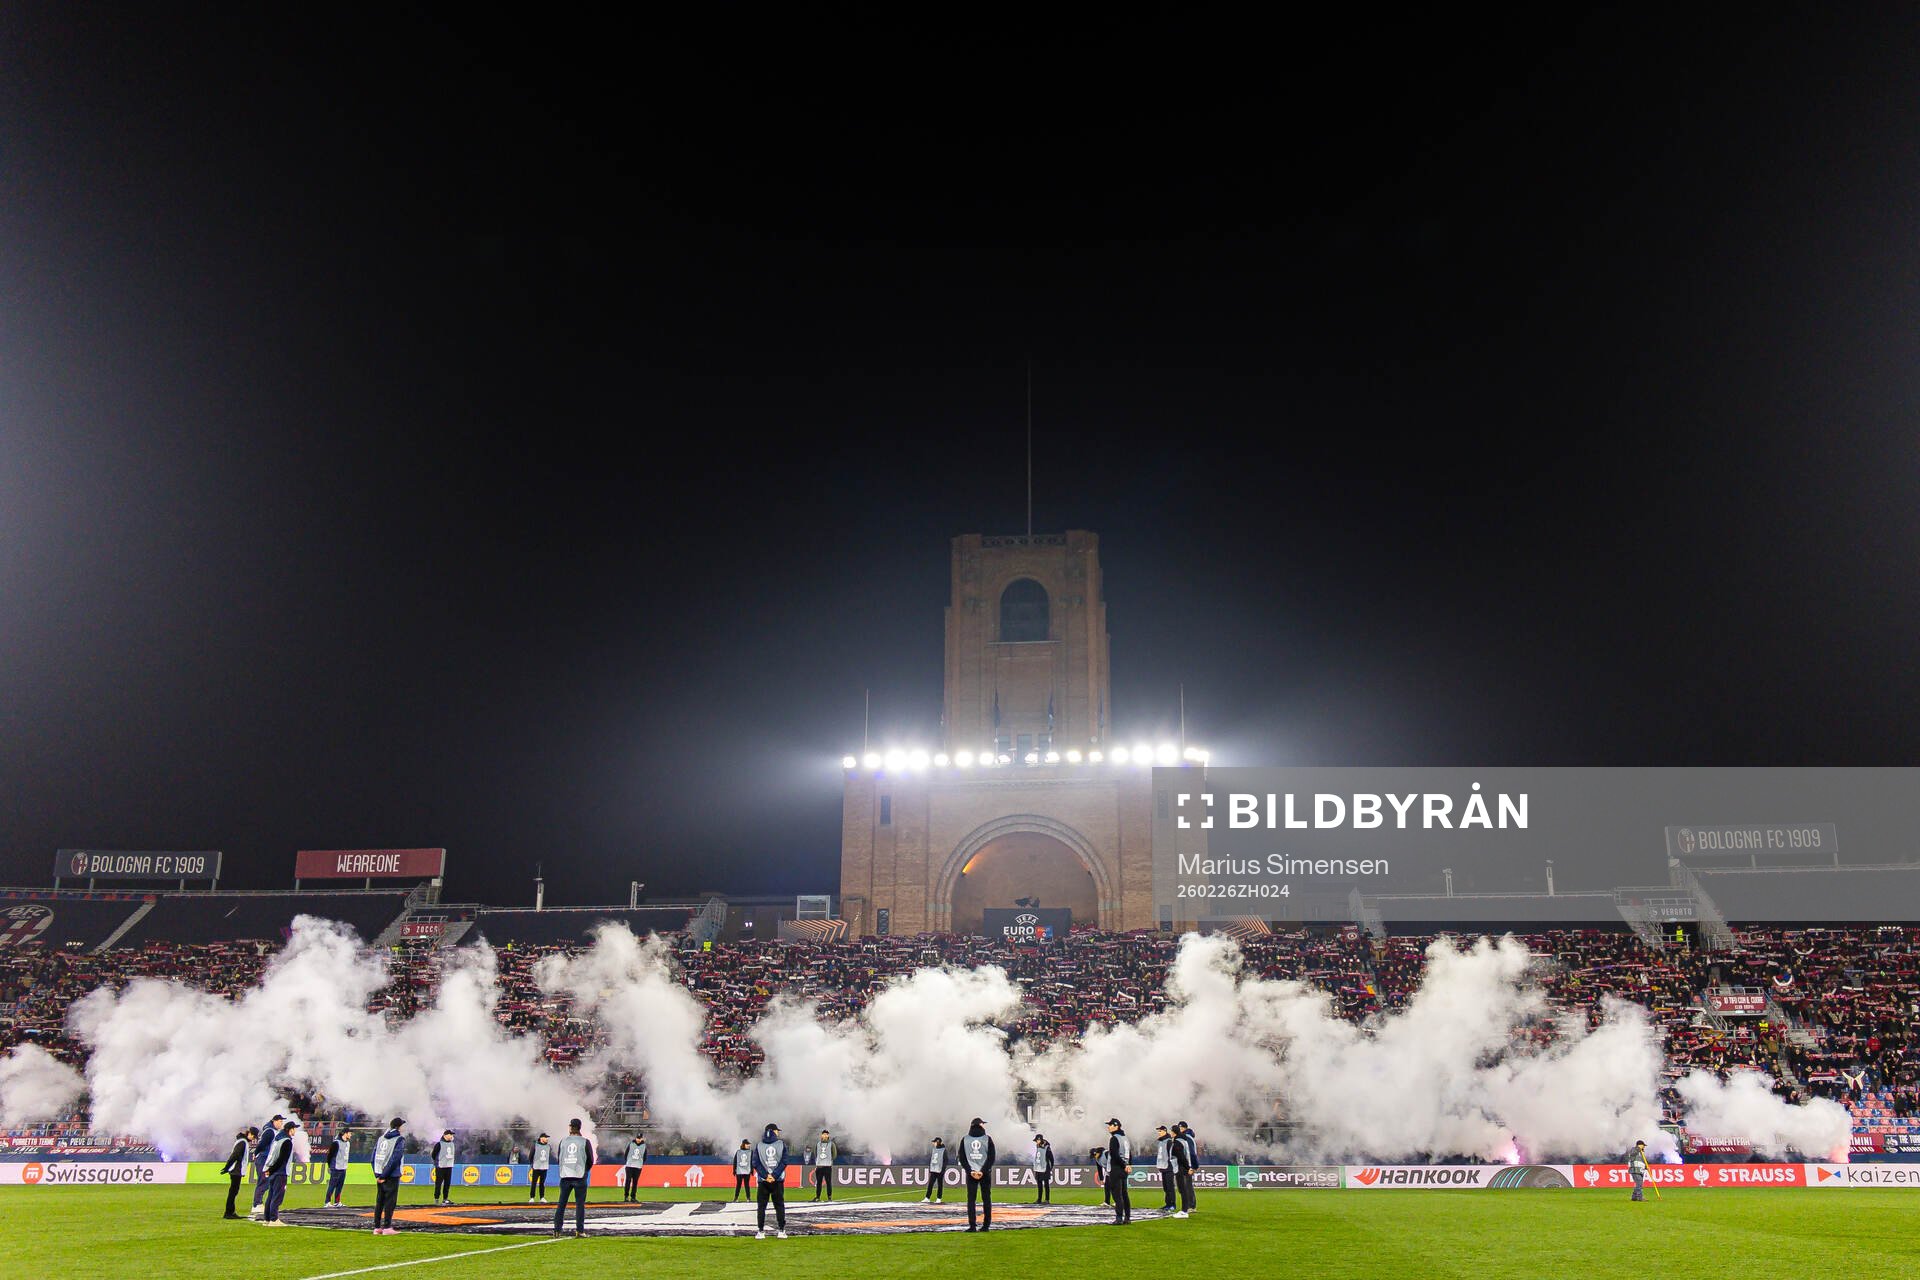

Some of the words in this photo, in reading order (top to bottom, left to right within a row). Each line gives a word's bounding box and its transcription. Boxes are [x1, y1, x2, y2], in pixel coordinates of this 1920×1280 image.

[1699, 831, 1762, 849] BOLOGNA
[1767, 830, 1784, 848] FC
[1787, 829, 1820, 847] 1909
[91, 856, 150, 873] BOLOGNA
[155, 857, 171, 873] FC
[175, 857, 204, 873] 1909
[337, 855, 400, 872] WEAREONE
[1016, 915, 1037, 924] UEFA
[1003, 926, 1035, 935] EURO
[45, 1163, 154, 1184] Swissquote
[838, 1168, 896, 1184] UEFA
[996, 1168, 1082, 1185] LEAUE
[1243, 1170, 1338, 1184] enterprise
[1718, 1168, 1796, 1182] STRAUSS
[1847, 1166, 1920, 1183] kaizen
